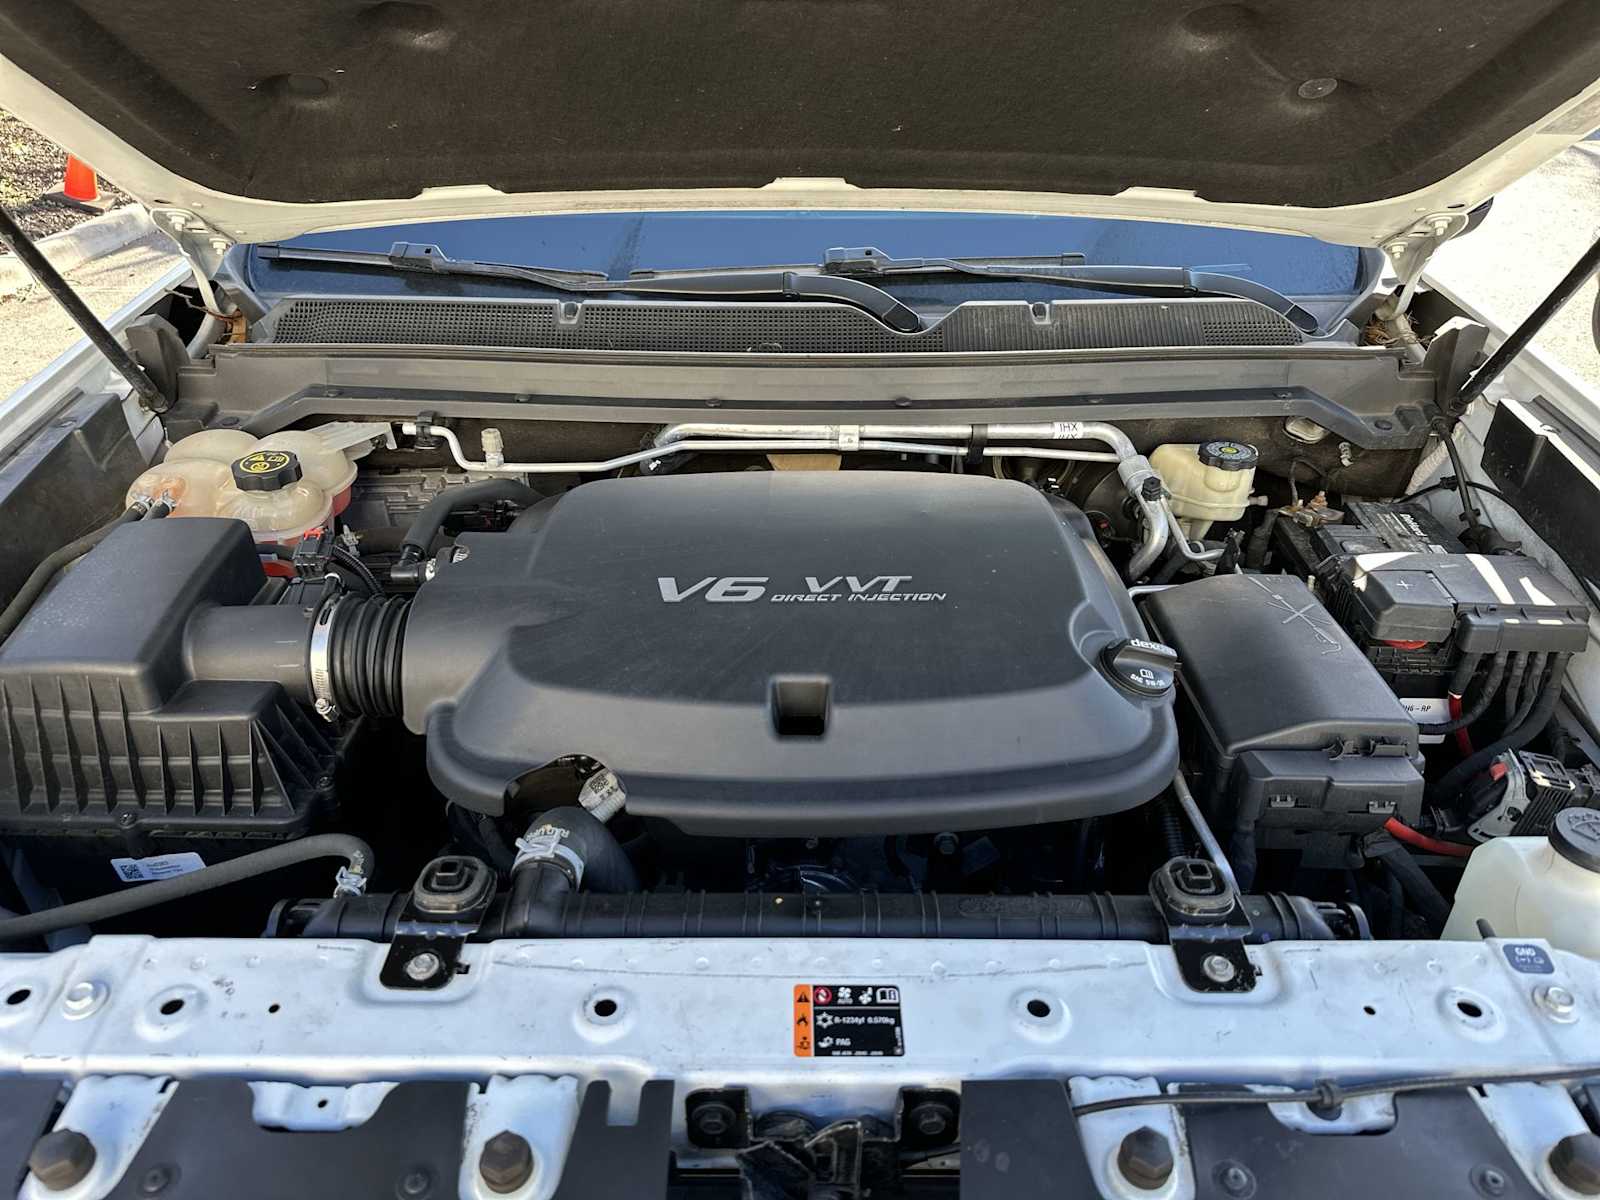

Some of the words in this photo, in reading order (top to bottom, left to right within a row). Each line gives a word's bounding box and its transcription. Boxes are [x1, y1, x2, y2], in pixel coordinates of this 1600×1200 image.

[657, 576, 769, 602] V6
[805, 575, 912, 593] VVT
[770, 593, 842, 602] DIRECT
[848, 593, 947, 601] INJECTION
